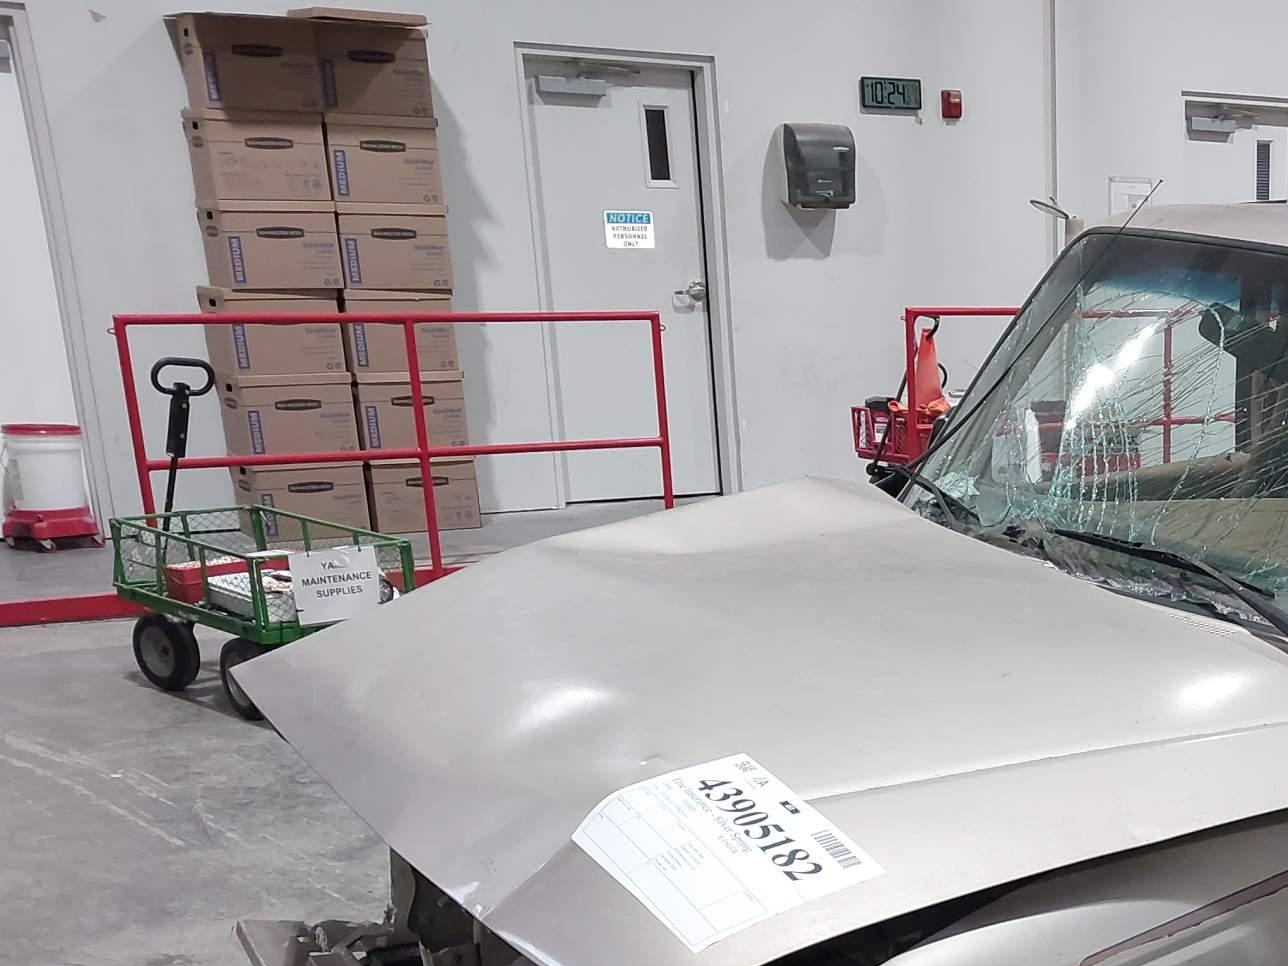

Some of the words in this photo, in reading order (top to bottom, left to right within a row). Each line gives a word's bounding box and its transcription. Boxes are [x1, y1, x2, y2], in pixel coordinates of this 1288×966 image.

[871, 81, 905, 104] 10:24
[336, 152, 348, 194] MEDIUM
[609, 213, 649, 223] NOTICE
[230, 238, 244, 281] MEDIUM
[347, 240, 360, 281] MEDIUM
[234, 325, 249, 368] MEDIUM
[354, 325, 367, 365] MEDIUM
[249, 412, 264, 453] MEDIUM
[367, 407, 380, 448] MEDIUM
[302, 571, 372, 587] MAINTENANCE
[316, 585, 364, 599] SUPPLIES
[698, 779, 823, 881] 43905182
